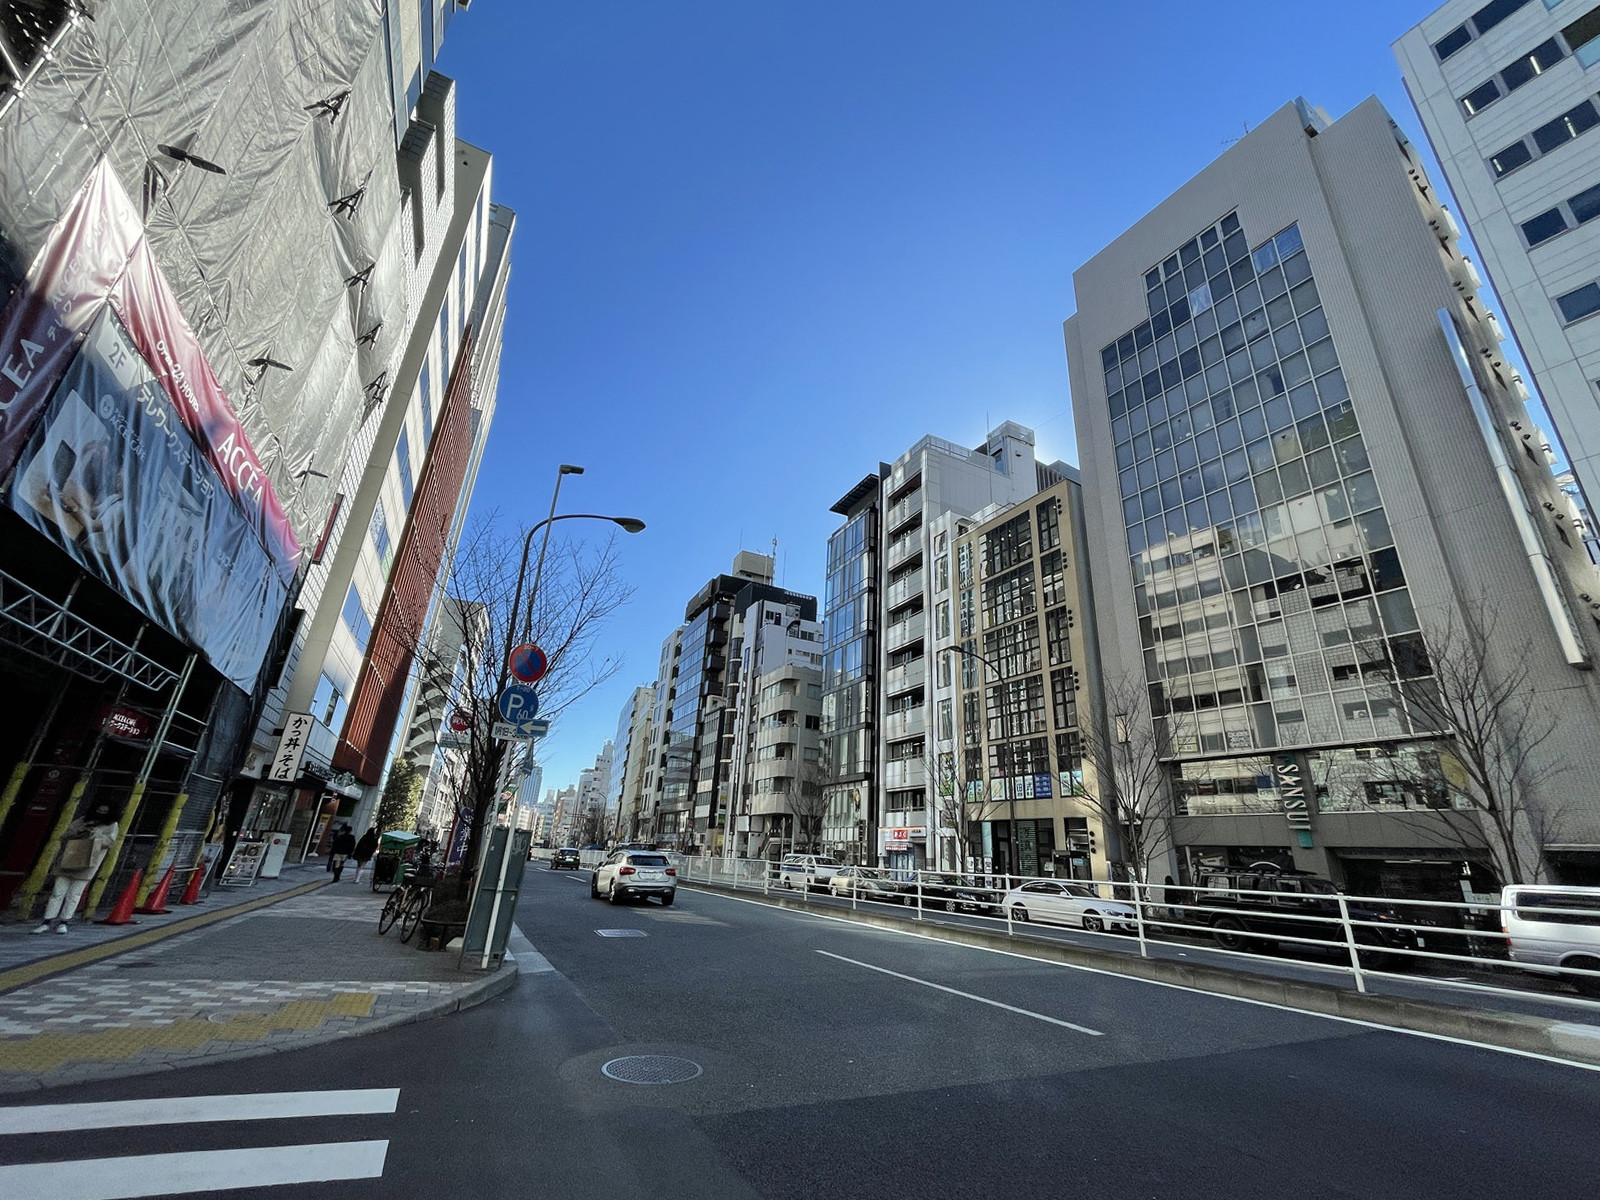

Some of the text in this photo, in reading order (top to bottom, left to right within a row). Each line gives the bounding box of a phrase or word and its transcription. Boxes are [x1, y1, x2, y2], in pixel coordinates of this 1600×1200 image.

[108, 342, 127, 370] 2F
[179, 380, 200, 413] HOURS
[505, 693, 525, 719] P
[274, 716, 308, 780] かつ丼・そば
[1276, 763, 1312, 831] SANSUI
